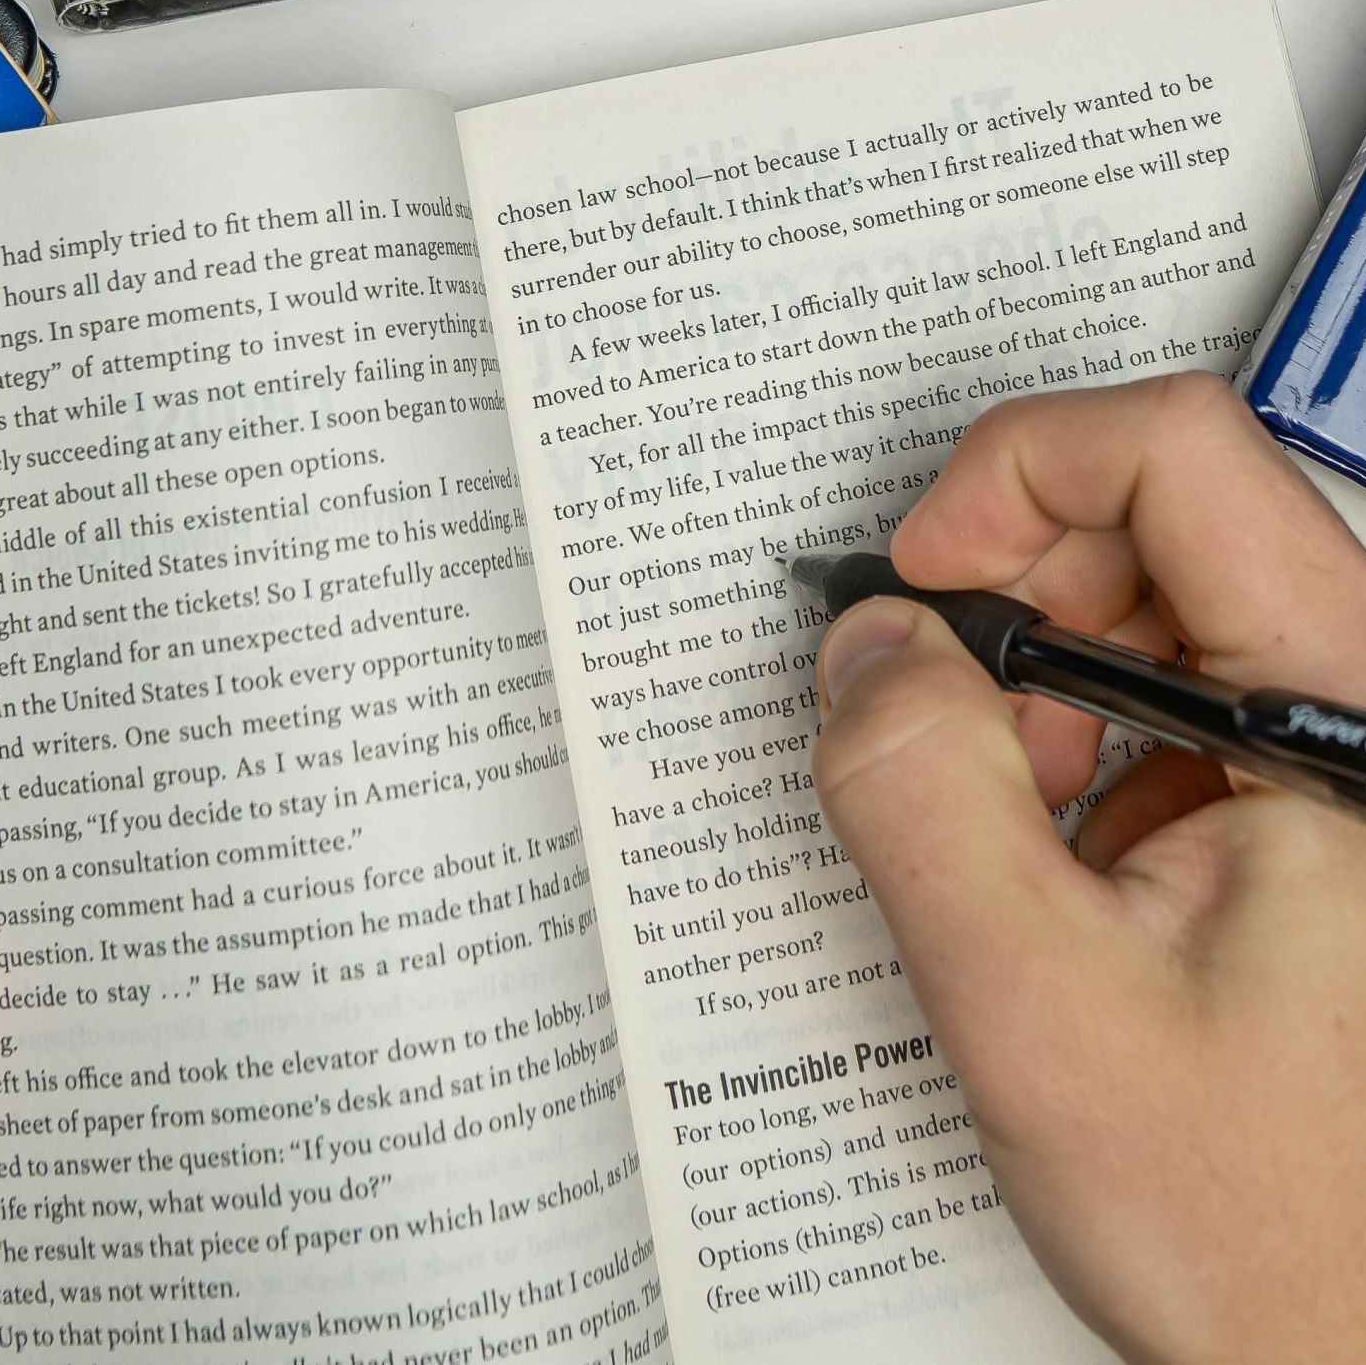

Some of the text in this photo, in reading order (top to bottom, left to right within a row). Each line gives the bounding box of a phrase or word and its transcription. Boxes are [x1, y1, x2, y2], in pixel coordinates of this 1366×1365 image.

[0, 240, 43, 266] had
[49, 230, 123, 259] simply
[129, 219, 187, 247] tried
[193, 222, 217, 239] to
[224, 212, 251, 235] fit
[256, 208, 319, 230] them
[326, 200, 354, 223] all
[360, 200, 386, 220] in.
[391, 199, 401, 217] I
[406, 197, 453, 221] would
[518, 284, 720, 335] in to choose for us.
[540, 314, 1146, 446] a teacher. You’re reading this now because of that choice.
[55, 481, 116, 505] about
[122, 472, 149, 497] all
[155, 469, 217, 492] these
[225, 462, 283, 488] open
[290, 448, 384, 478] options.
[23, 866, 49, 883] on
[55, 864, 67, 880] a
[72, 847, 210, 879] consultation
[216, 827, 362, 866] committee.”
[644, 931, 823, 984] another person?
[664, 1035, 933, 1110] The Invincible Power
[34, 1194, 86, 1224] right
[92, 1199, 142, 1219] now,
[148, 1189, 204, 1215] what
[210, 1182, 282, 1211] would
[289, 1186, 332, 1212] you
[340, 1174, 391, 1202] do?”
[707, 1246, 945, 1314] (free will) cannot be.
